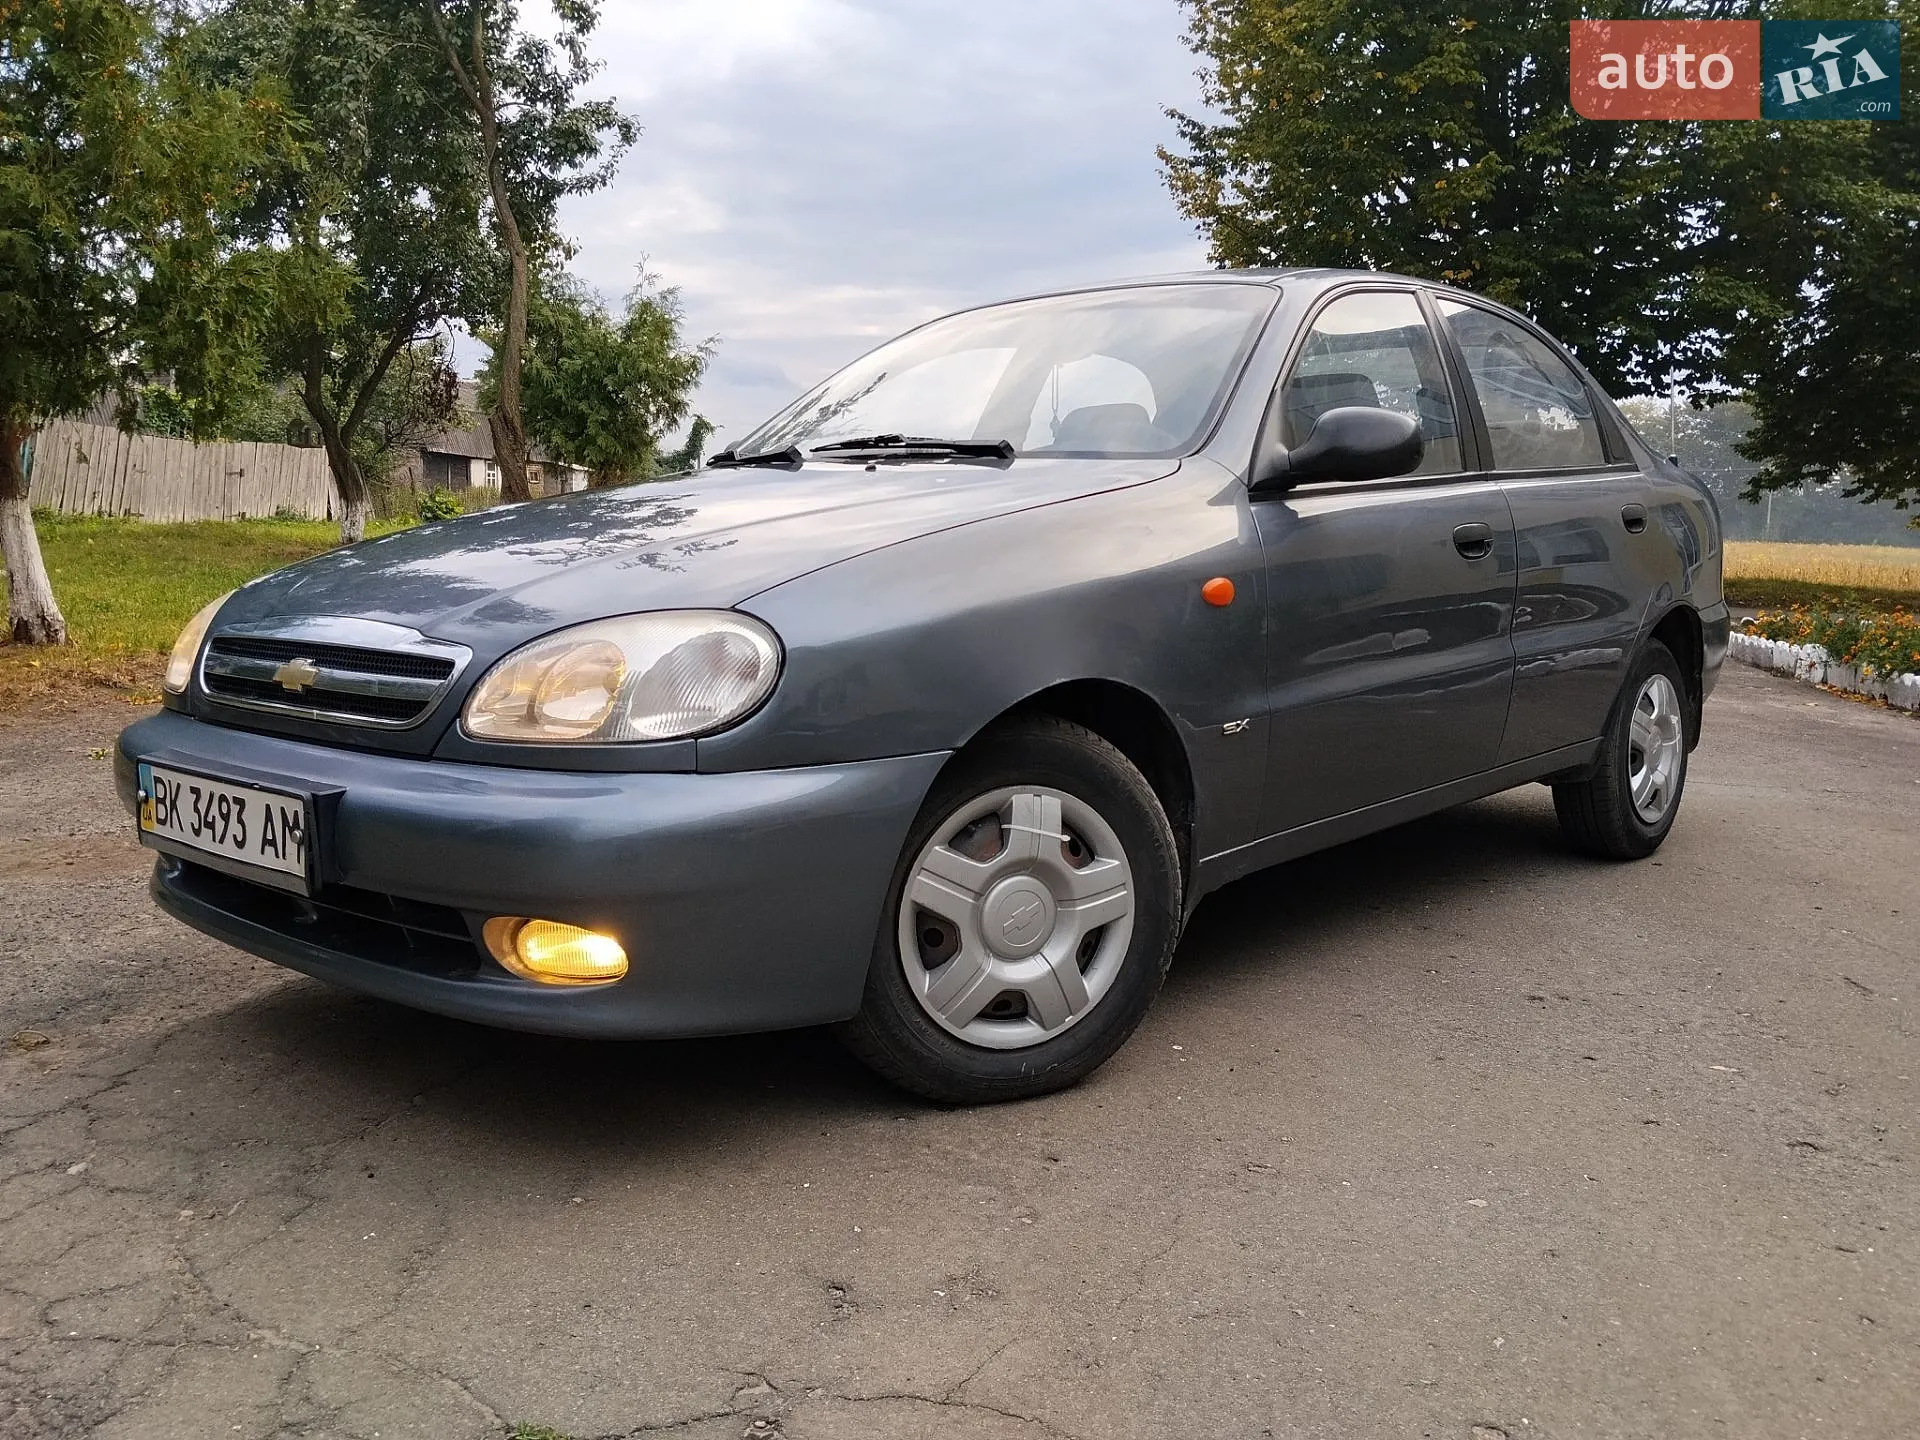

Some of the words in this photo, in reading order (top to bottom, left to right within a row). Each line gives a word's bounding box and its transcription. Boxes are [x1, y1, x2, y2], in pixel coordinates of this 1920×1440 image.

[142, 807, 153, 823] UA
[153, 776, 185, 832] BK
[189, 786, 248, 850] 3493
[261, 803, 301, 865] AM
